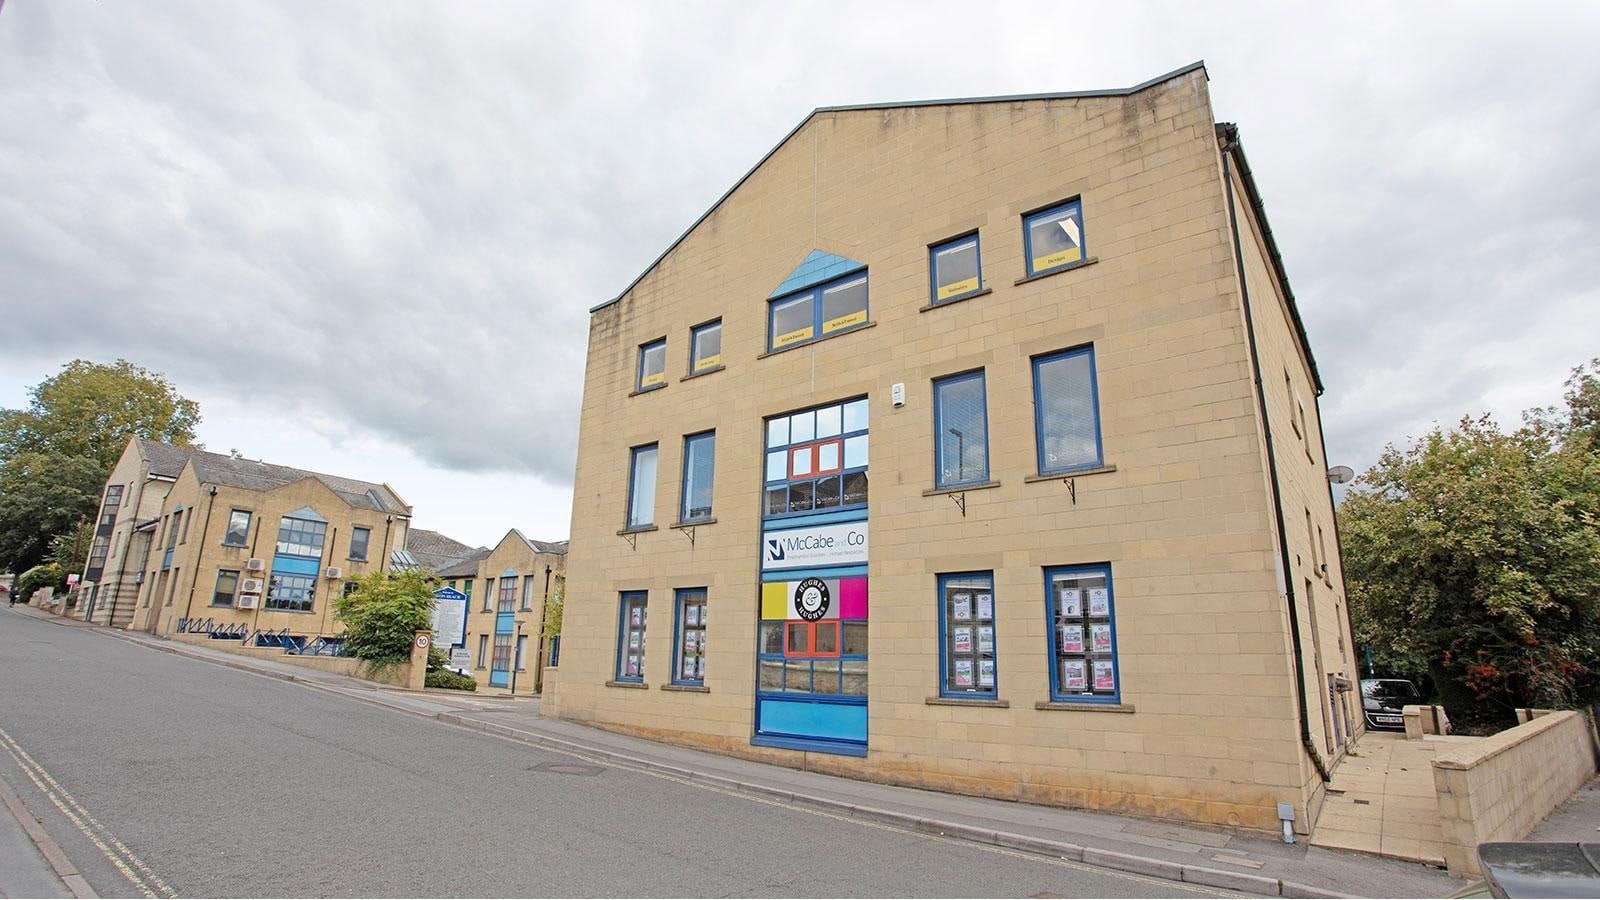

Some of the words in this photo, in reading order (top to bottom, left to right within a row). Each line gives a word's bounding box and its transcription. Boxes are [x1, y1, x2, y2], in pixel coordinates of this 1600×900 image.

[787, 535, 834, 551] McCabe
[847, 531, 865, 546] Co
[799, 579, 826, 593] HUGHES
[805, 592, 818, 606] &
[799, 606, 826, 620] HUGHES
